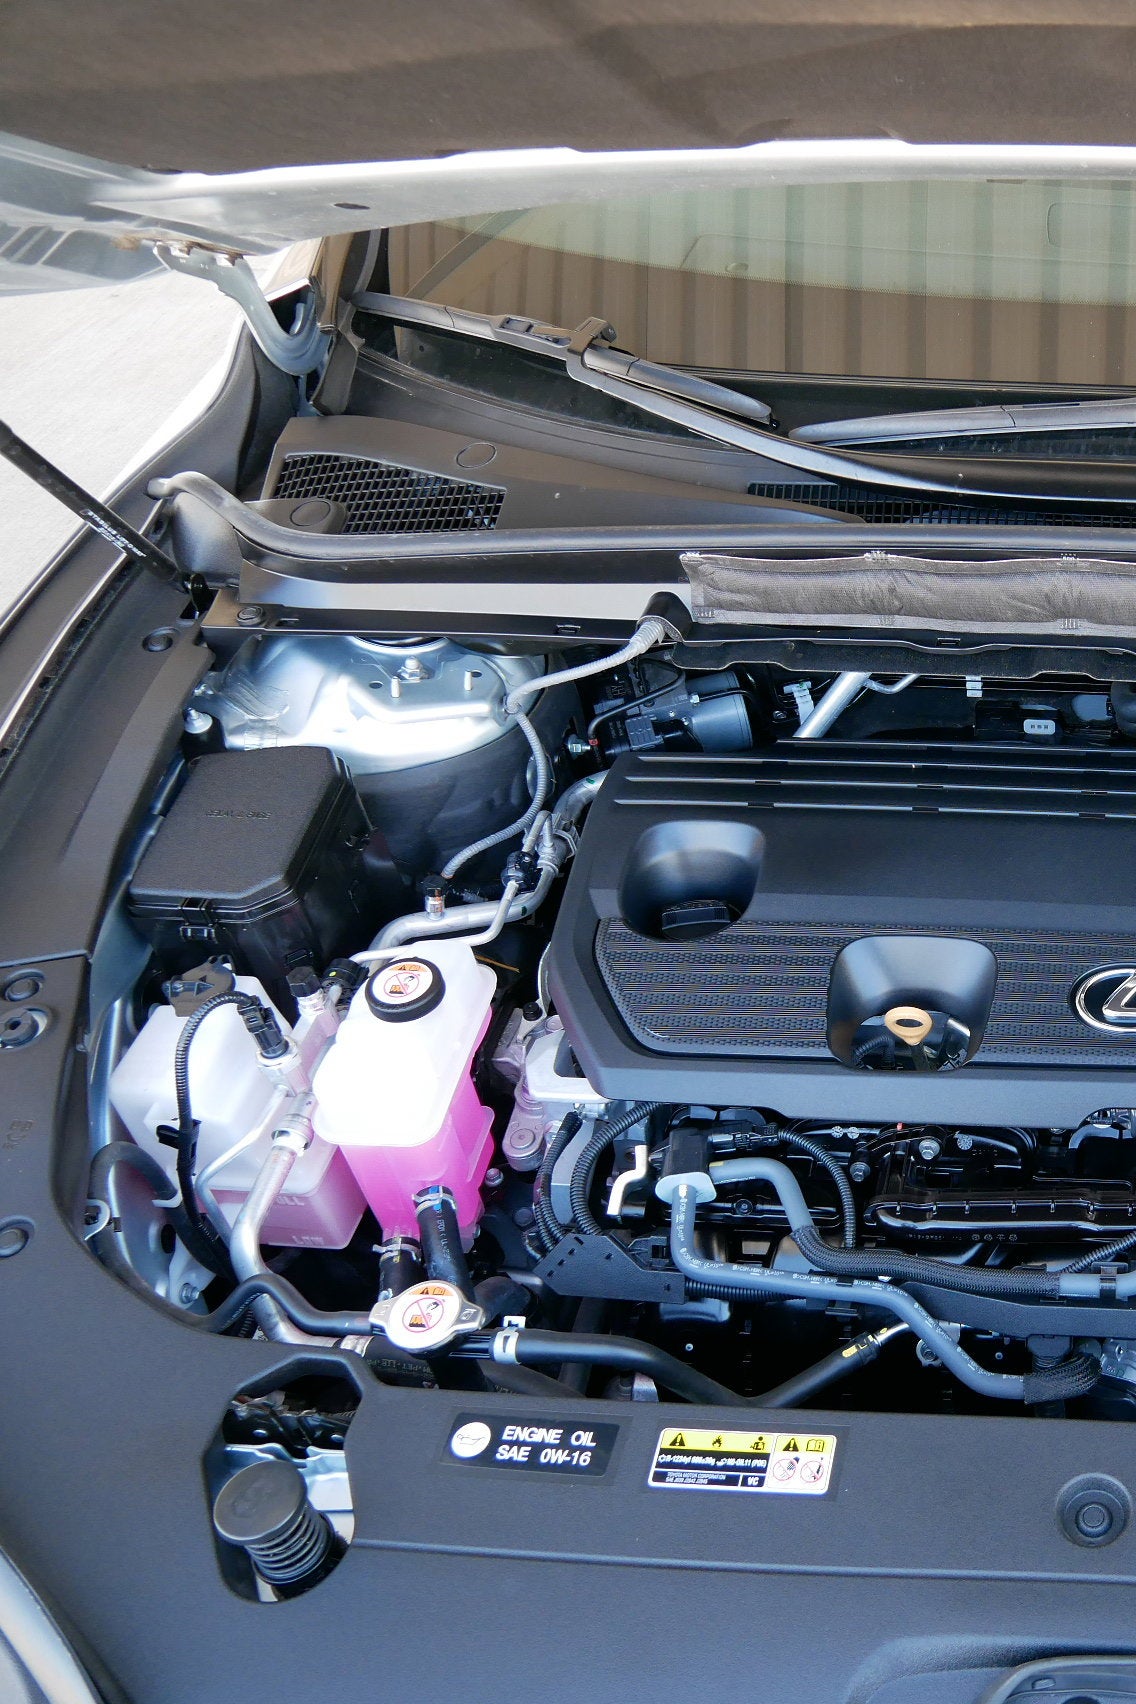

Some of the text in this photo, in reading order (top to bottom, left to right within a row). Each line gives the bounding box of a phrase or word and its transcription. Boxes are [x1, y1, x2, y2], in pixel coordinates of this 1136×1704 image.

[501, 1425, 597, 1447] ENGINE OIL
[495, 1444, 592, 1466] SAE 0W-16
[747, 1476, 760, 1486] VC
